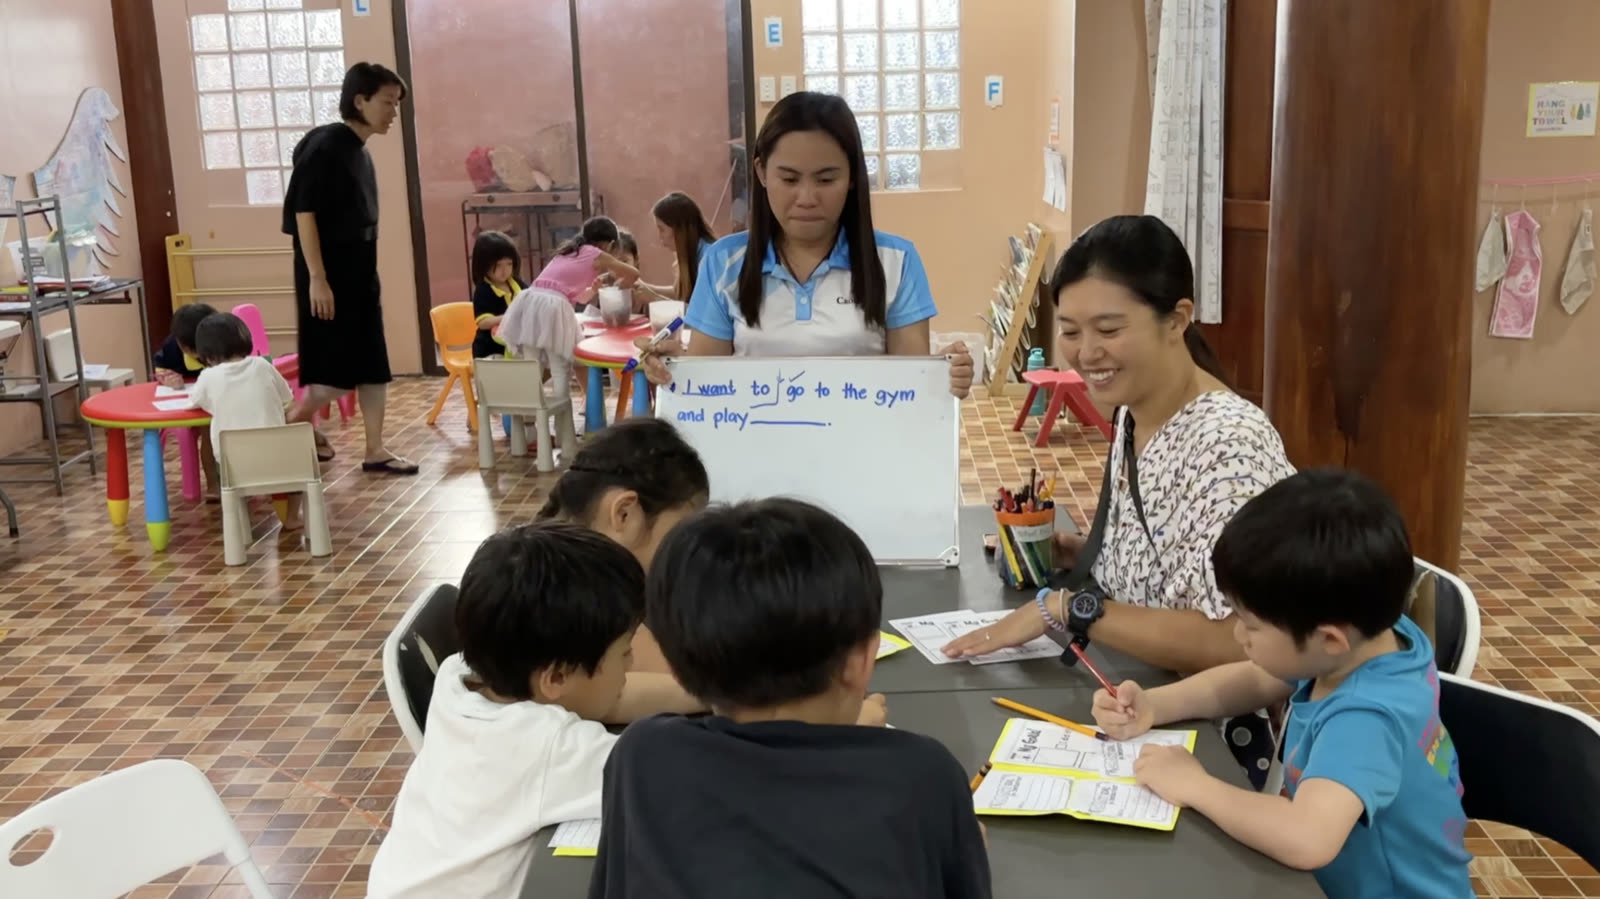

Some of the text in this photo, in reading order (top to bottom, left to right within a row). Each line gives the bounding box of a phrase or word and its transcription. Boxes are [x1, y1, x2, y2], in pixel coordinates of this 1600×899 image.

[768, 23, 780, 43] E
[989, 82, 1000, 101] F
[1536, 100, 1566, 108] HANG
[1532, 117, 1567, 125] TOWEL
[698, 380, 736, 396] want
[751, 380, 770, 396] to
[786, 385, 805, 402] go
[814, 382, 831, 398] to
[842, 382, 867, 400] the
[874, 390, 915, 408] gym
[677, 408, 749, 431] and play
